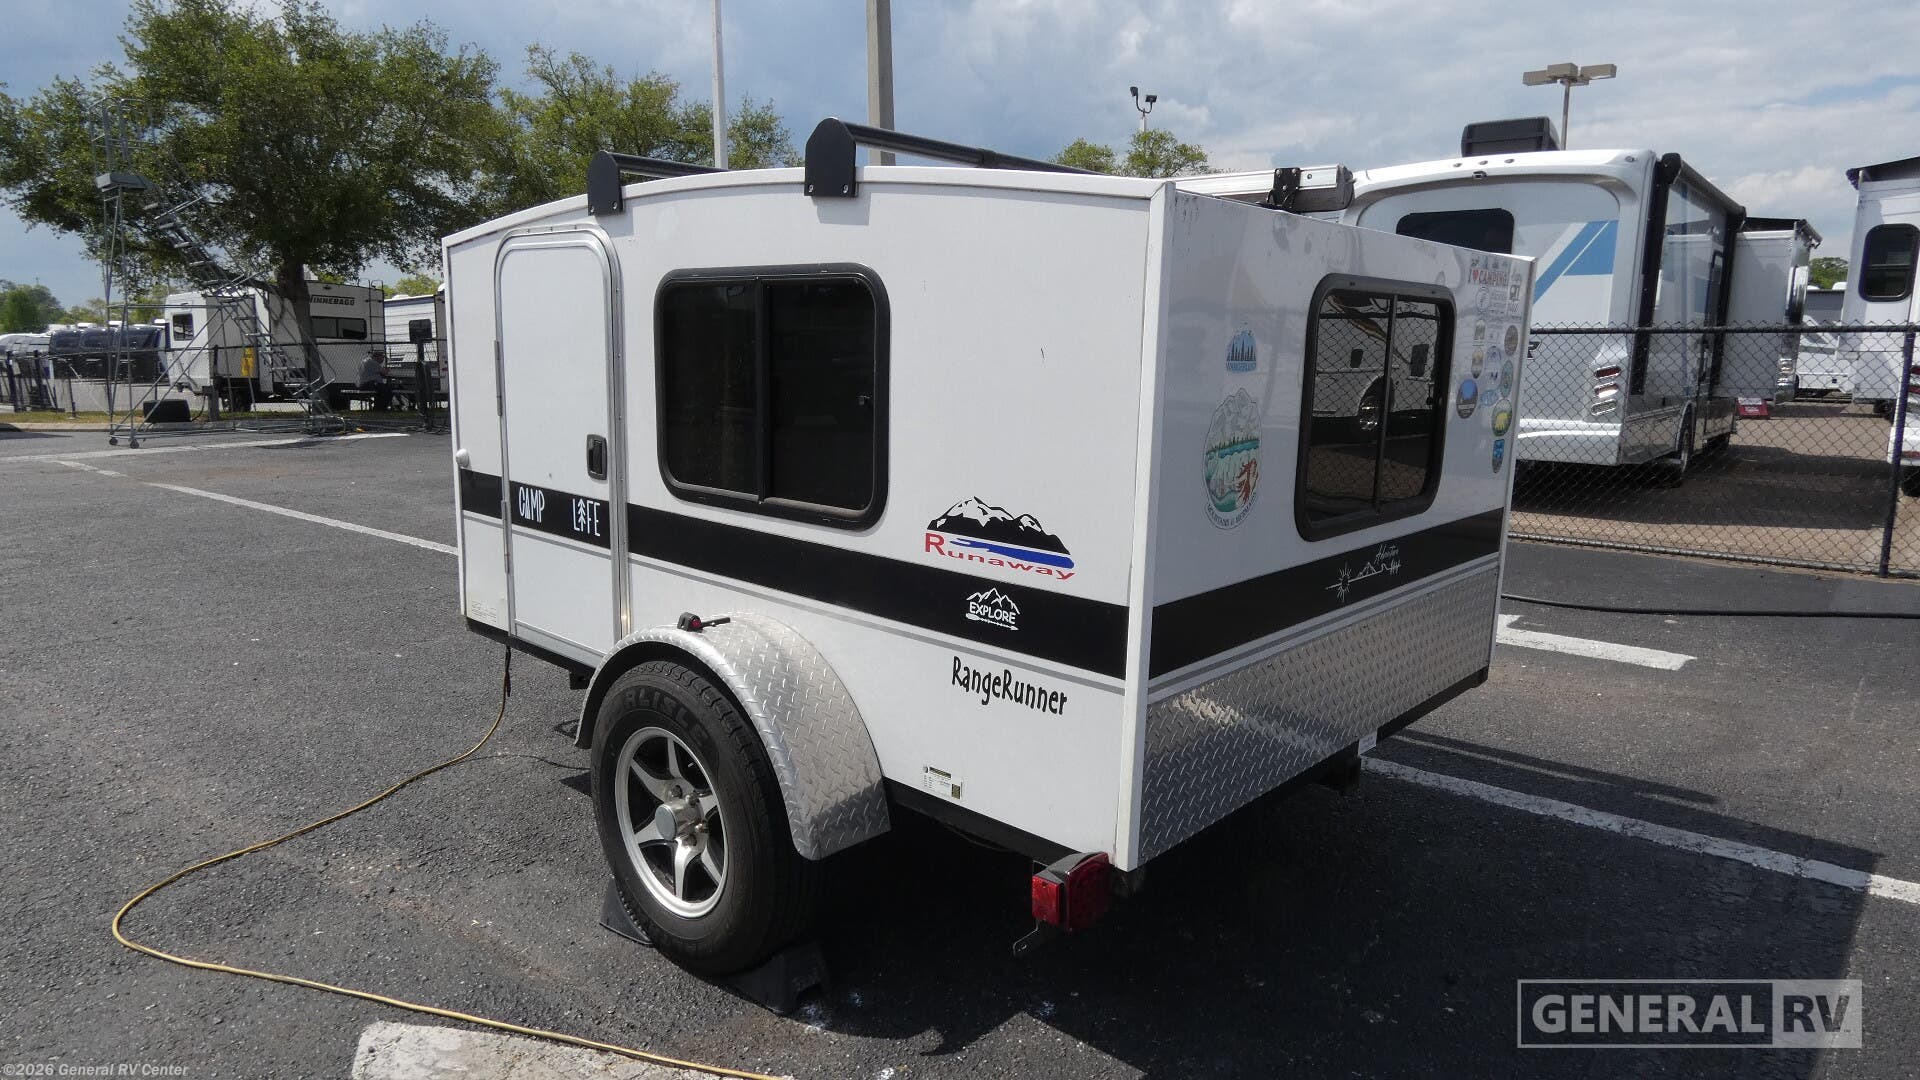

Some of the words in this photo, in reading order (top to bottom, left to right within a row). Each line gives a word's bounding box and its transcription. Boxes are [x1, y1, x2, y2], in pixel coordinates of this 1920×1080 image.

[518, 486, 546, 524] CAMP
[572, 498, 601, 537] LIFE
[924, 532, 1076, 581] Runaway
[969, 601, 1016, 625] EXPLORE
[951, 655, 1068, 716] RangeRunner
